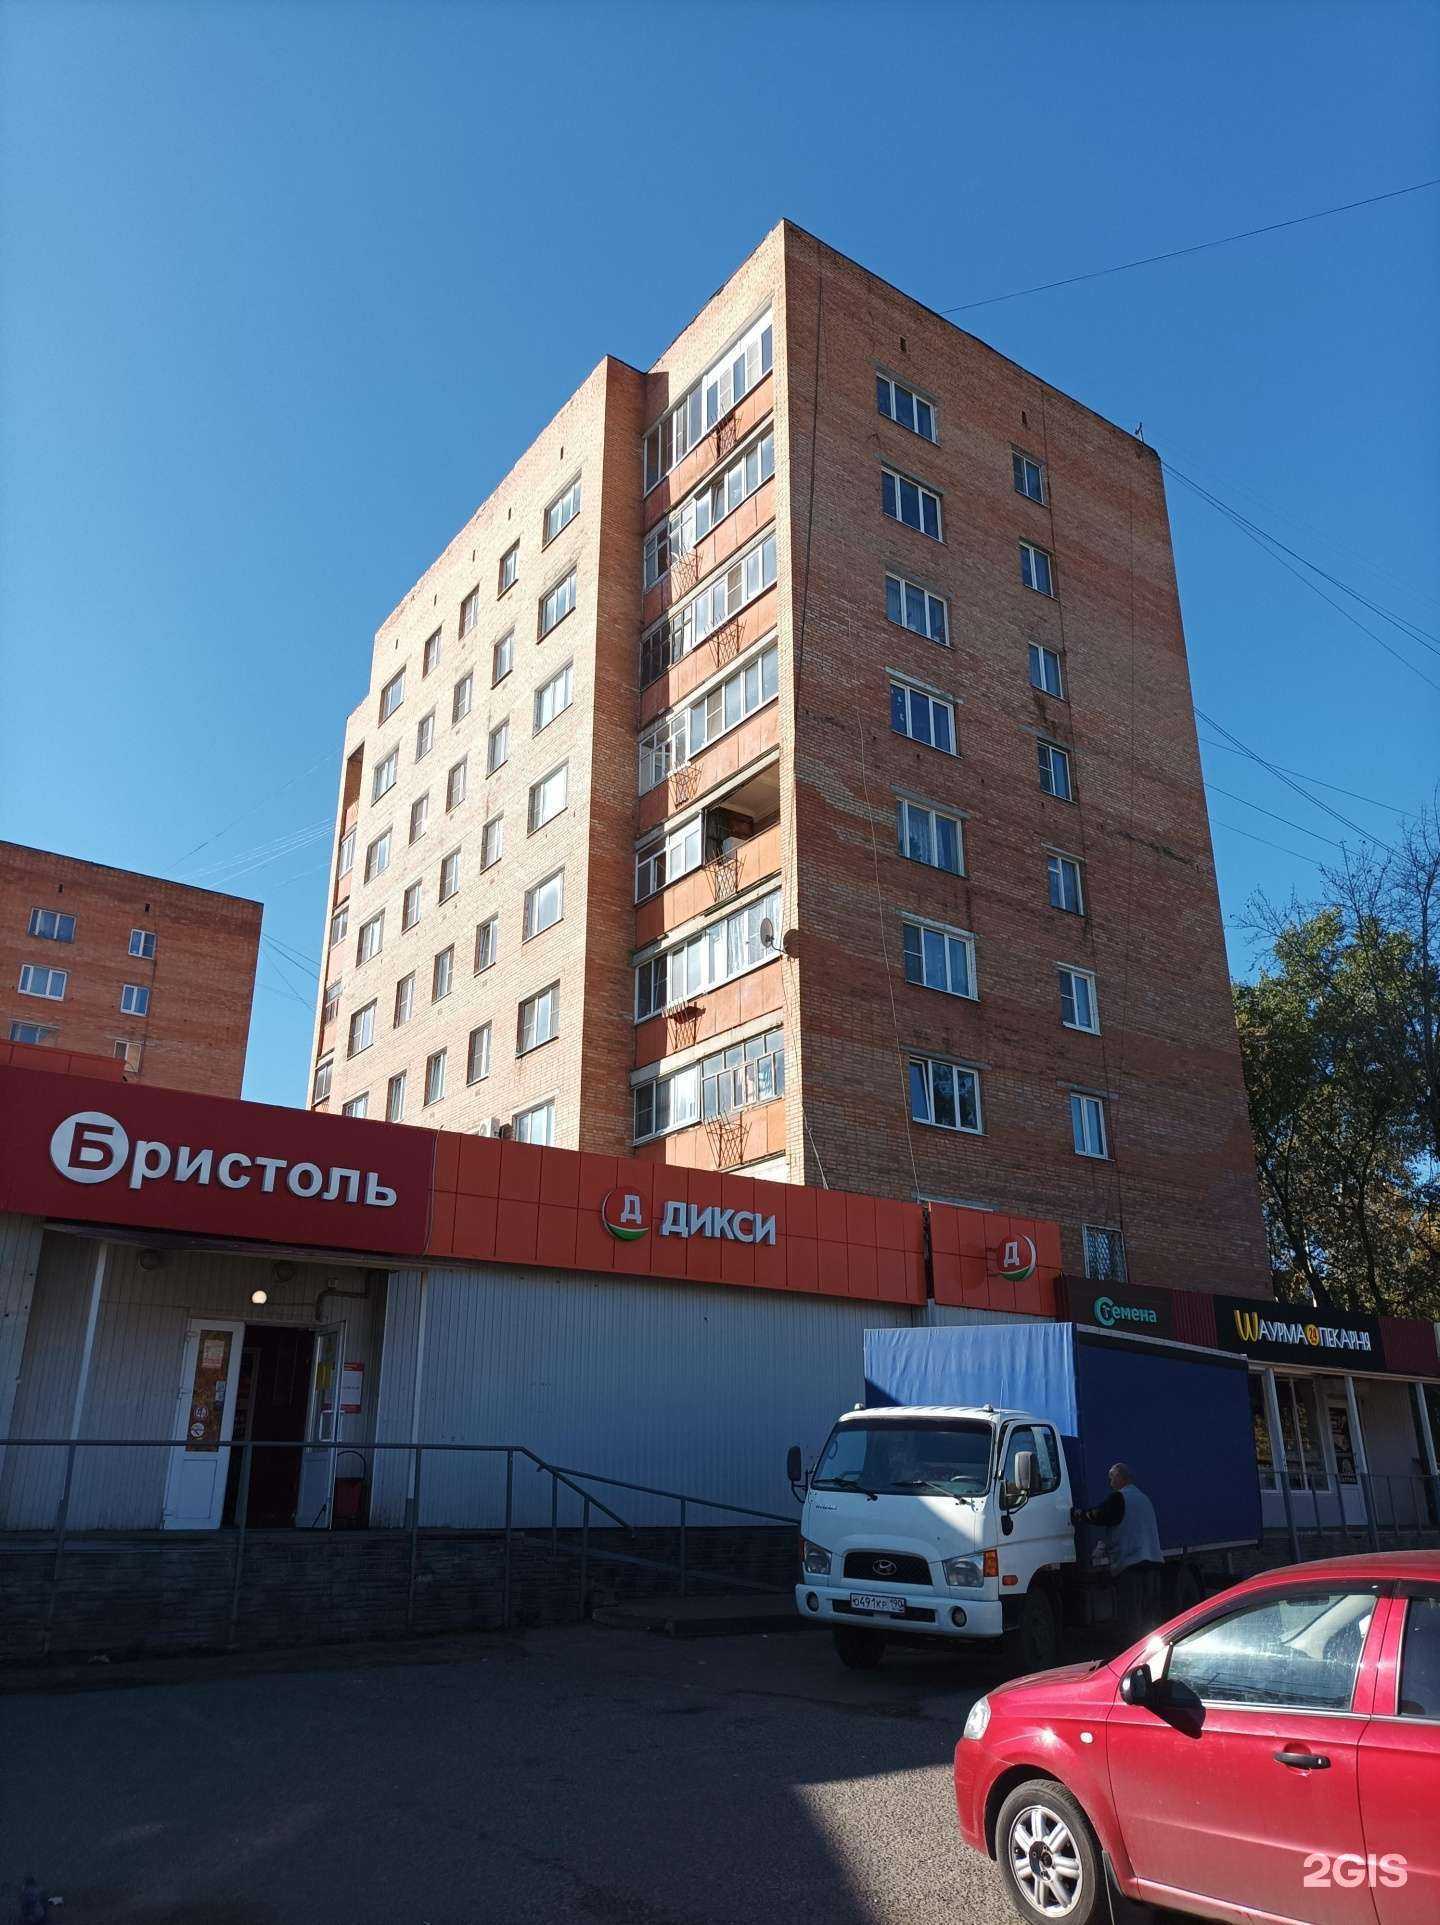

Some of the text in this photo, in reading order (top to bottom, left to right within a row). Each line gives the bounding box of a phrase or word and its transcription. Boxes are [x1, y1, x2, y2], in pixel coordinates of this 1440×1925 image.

[50, 1111, 398, 1207] Бристоль
[620, 1194, 777, 1246] Д ДИКСИ
[1003, 1241, 1020, 1268] Д
[1094, 1296, 1158, 1327] Семена
[1318, 1326, 1372, 1351] ПЕКАРНЯ
